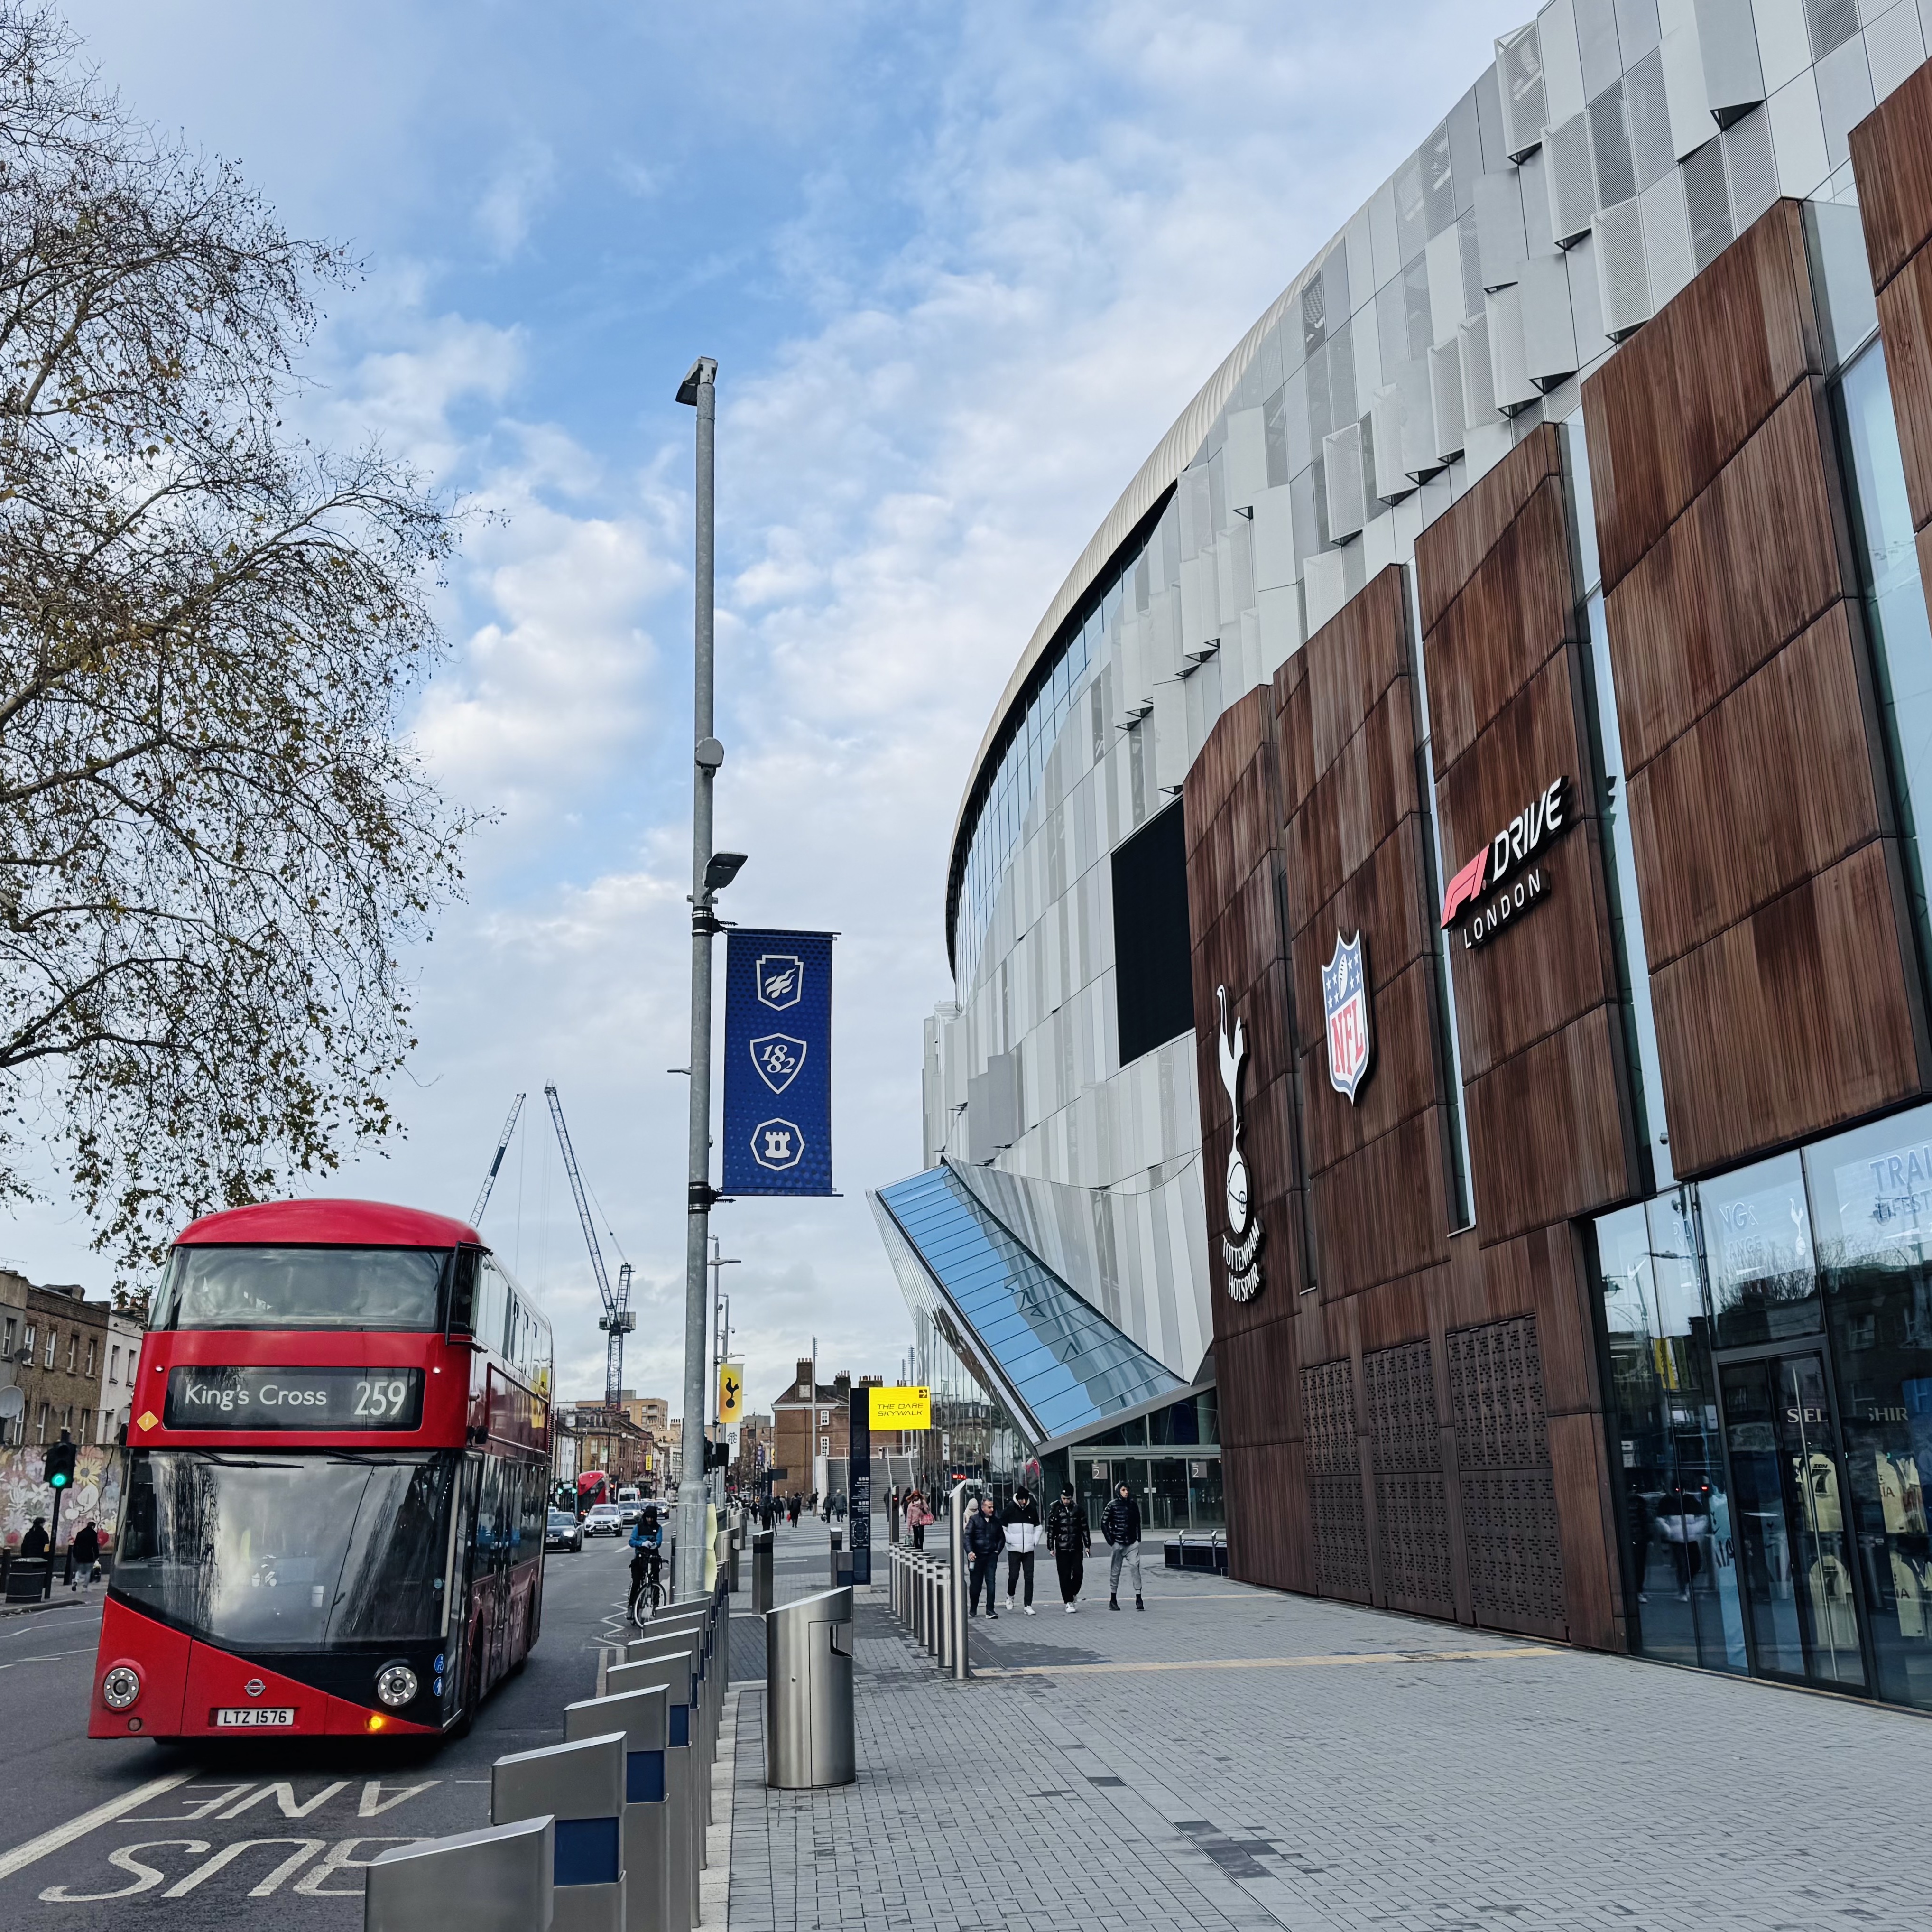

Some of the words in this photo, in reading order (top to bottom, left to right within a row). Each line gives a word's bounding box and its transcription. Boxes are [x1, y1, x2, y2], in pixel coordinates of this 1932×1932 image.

[1492, 776, 1564, 883] DRIVE
[1464, 869, 1541, 949] LONDON
[1331, 998, 1364, 1076] NFL
[1222, 1217, 1260, 1272] TOTTENHAM
[1228, 1262, 1260, 1302] HOTSPUR
[185, 1384, 250, 1411] King's
[259, 1384, 327, 1405] Cross
[354, 1381, 406, 1415] 259
[1092, 1469, 1100, 1479] 2
[1192, 1468, 1199, 1478] 2
[1812, 1468, 1832, 1494] 7
[223, 1711, 250, 1724] LTZ
[256, 1710, 287, 1723] 1576
[37, 1837, 436, 1902] BUS
